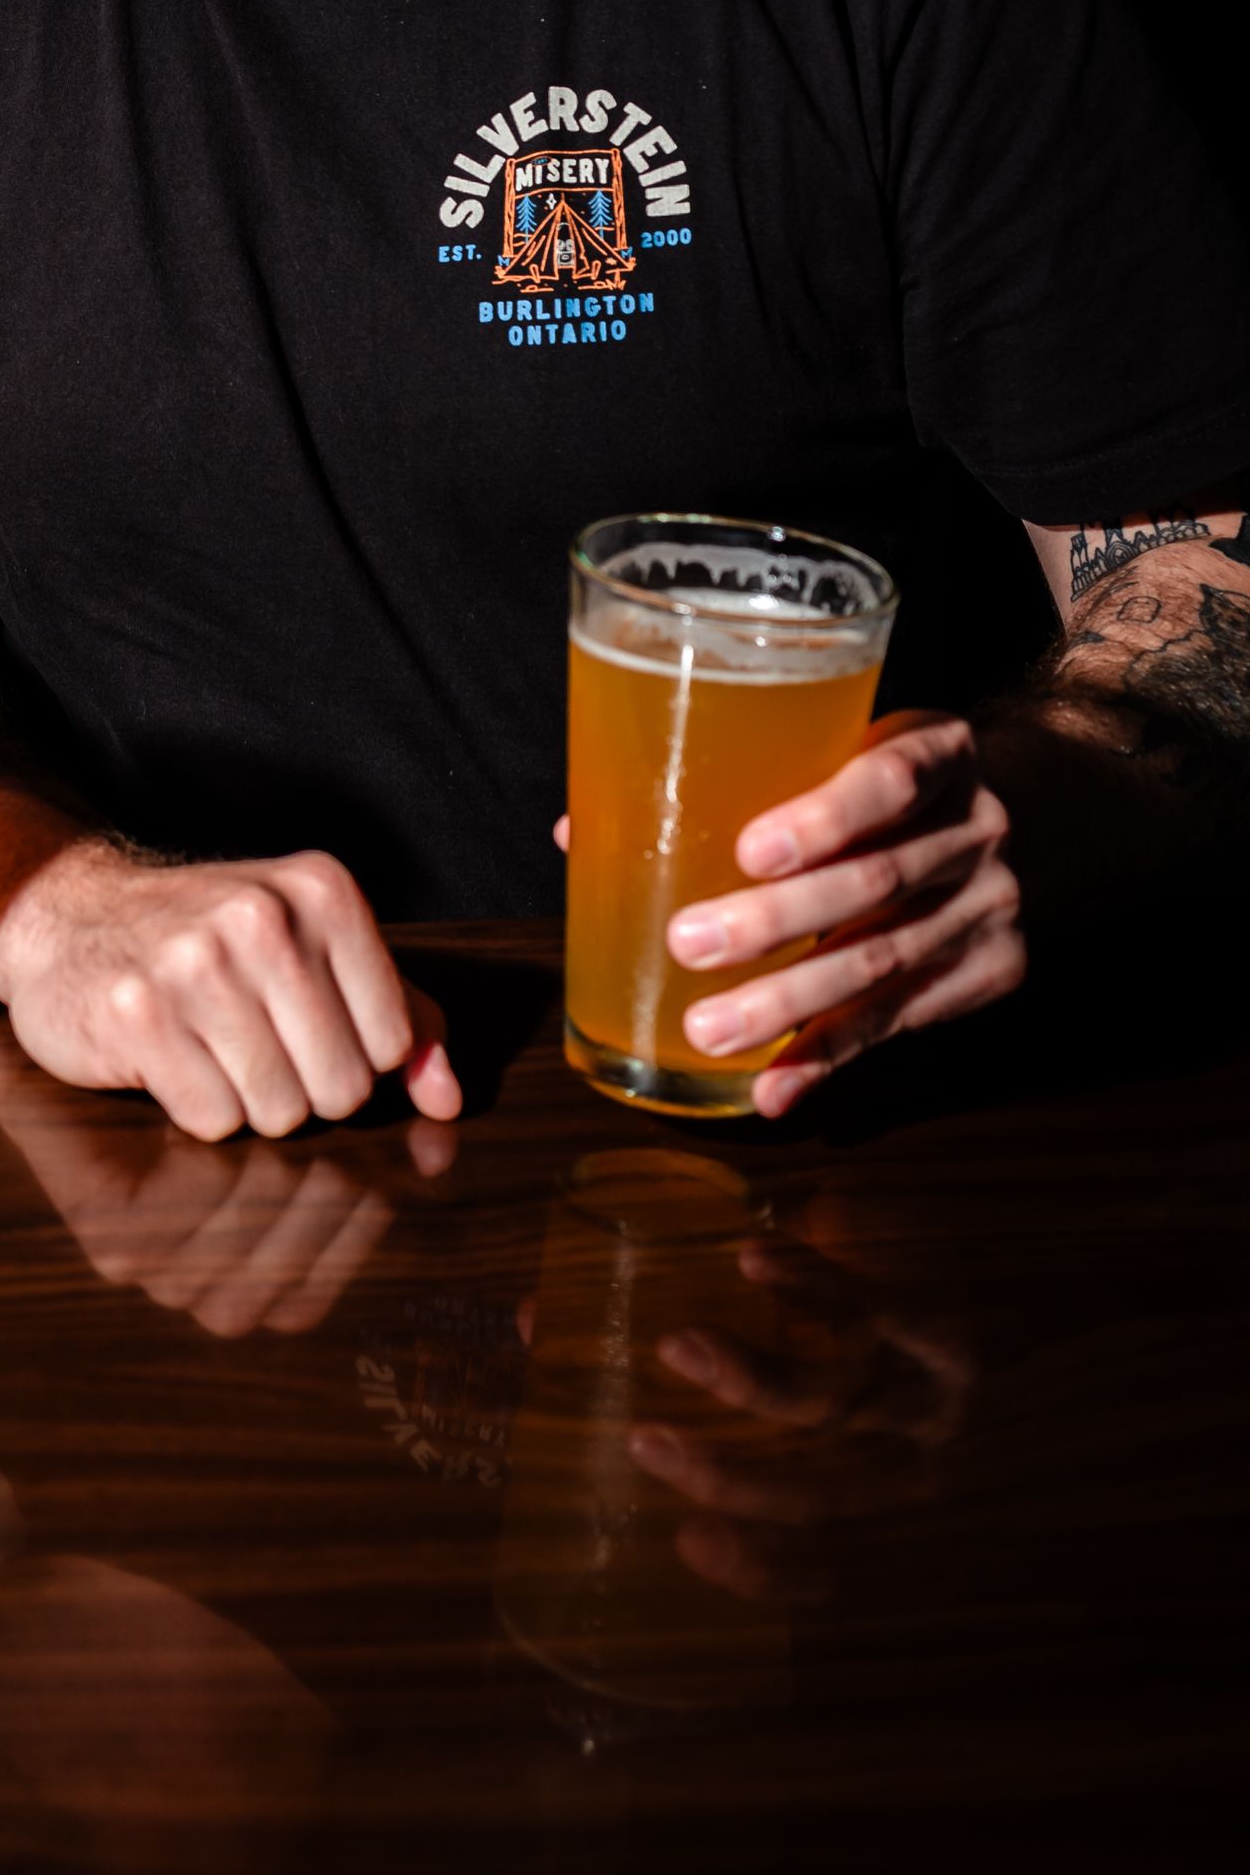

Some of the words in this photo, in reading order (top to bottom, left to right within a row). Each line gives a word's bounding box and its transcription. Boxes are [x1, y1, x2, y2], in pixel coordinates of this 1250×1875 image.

[439, 86, 691, 228] SILVERSTEIN
[515, 158, 610, 191] MISERY
[438, 245, 482, 263] EST.
[640, 228, 692, 248] 2000
[479, 293, 655, 323] BURLINGTON
[508, 320, 626, 347] ONTARIO
